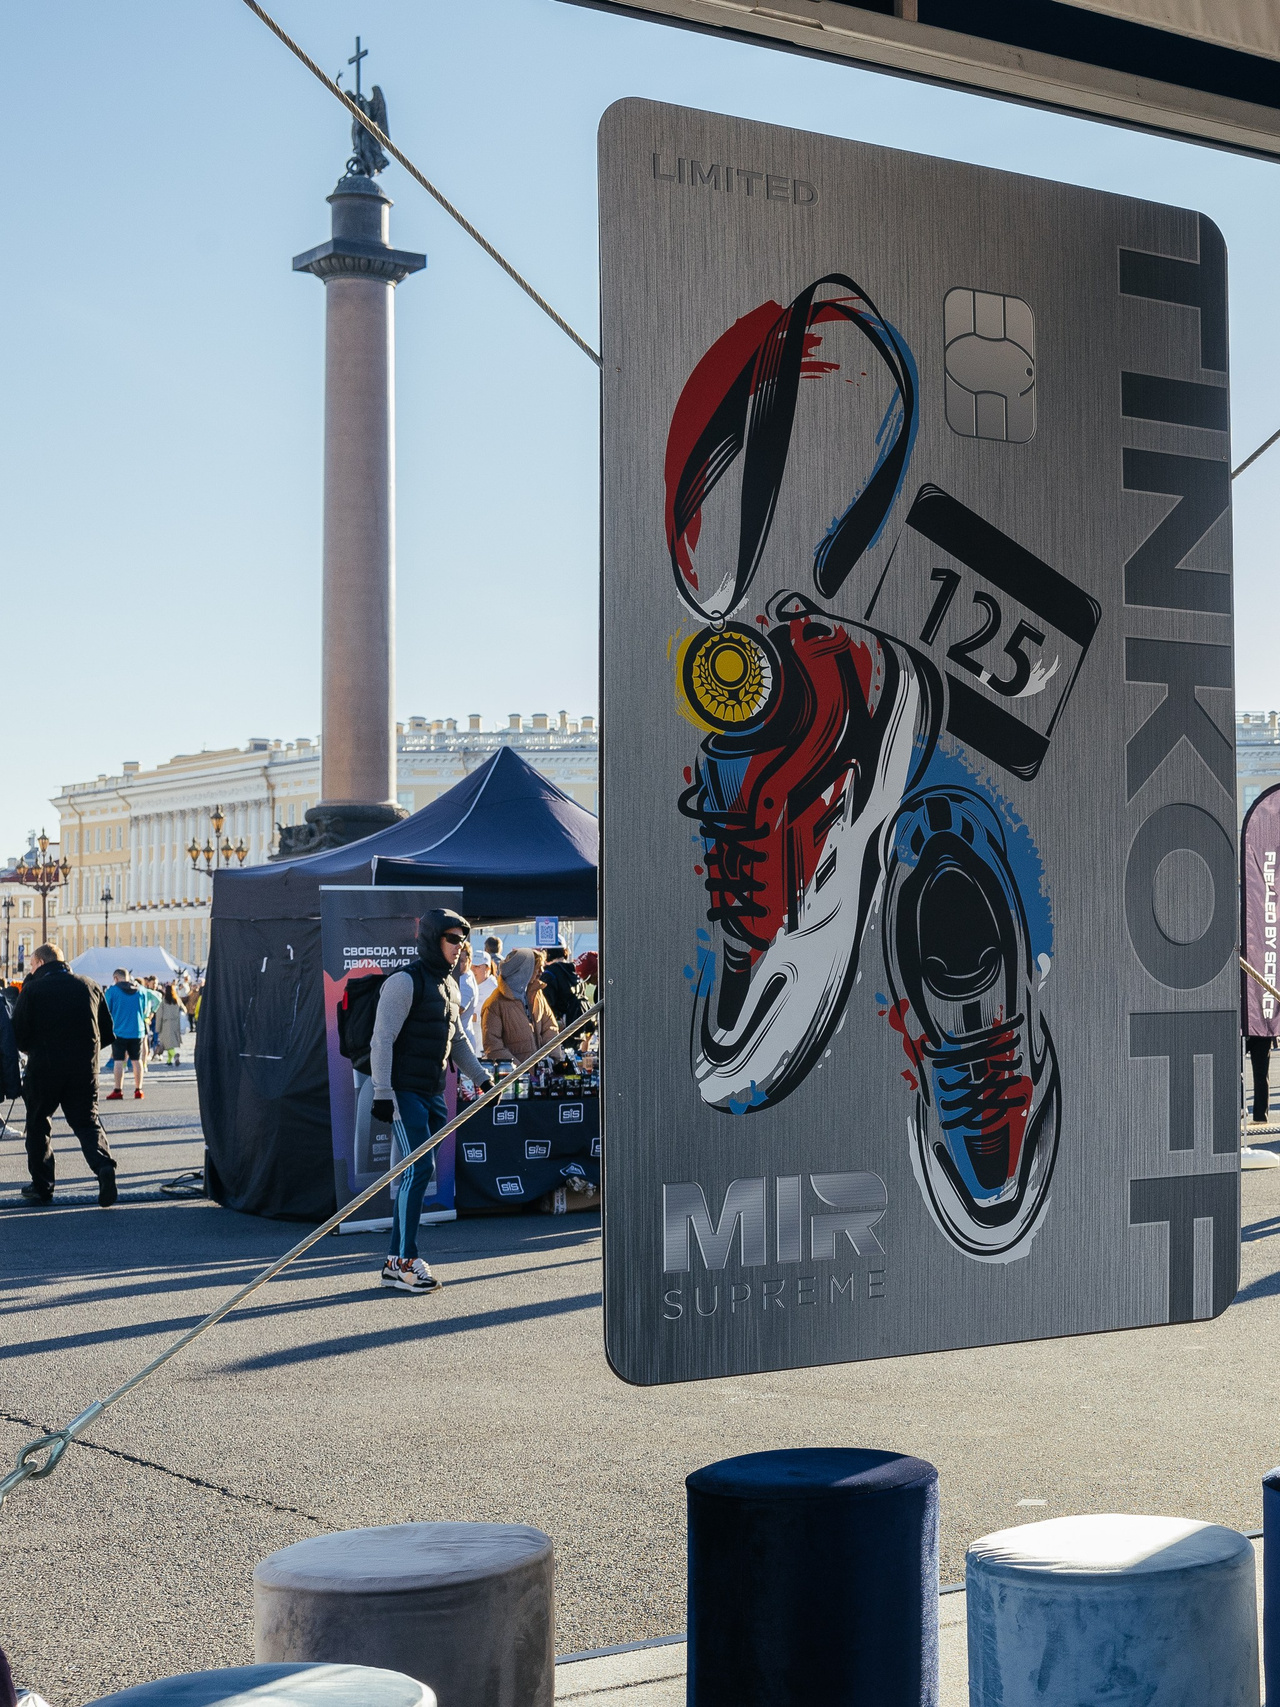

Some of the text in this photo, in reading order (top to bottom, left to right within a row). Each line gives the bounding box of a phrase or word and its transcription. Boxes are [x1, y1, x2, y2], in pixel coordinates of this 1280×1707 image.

[652, 152, 820, 208] LIMITED
[915, 566, 1049, 697] 125
[1118, 211, 1238, 1322] TINKOFF
[1264, 851, 1277, 924] FUELLED
[343, 946, 397, 957] СВОБОДА
[1264, 926, 1277, 949] BY
[662, 1169, 889, 1273] MIR
[662, 1269, 887, 1320] SUPREME
